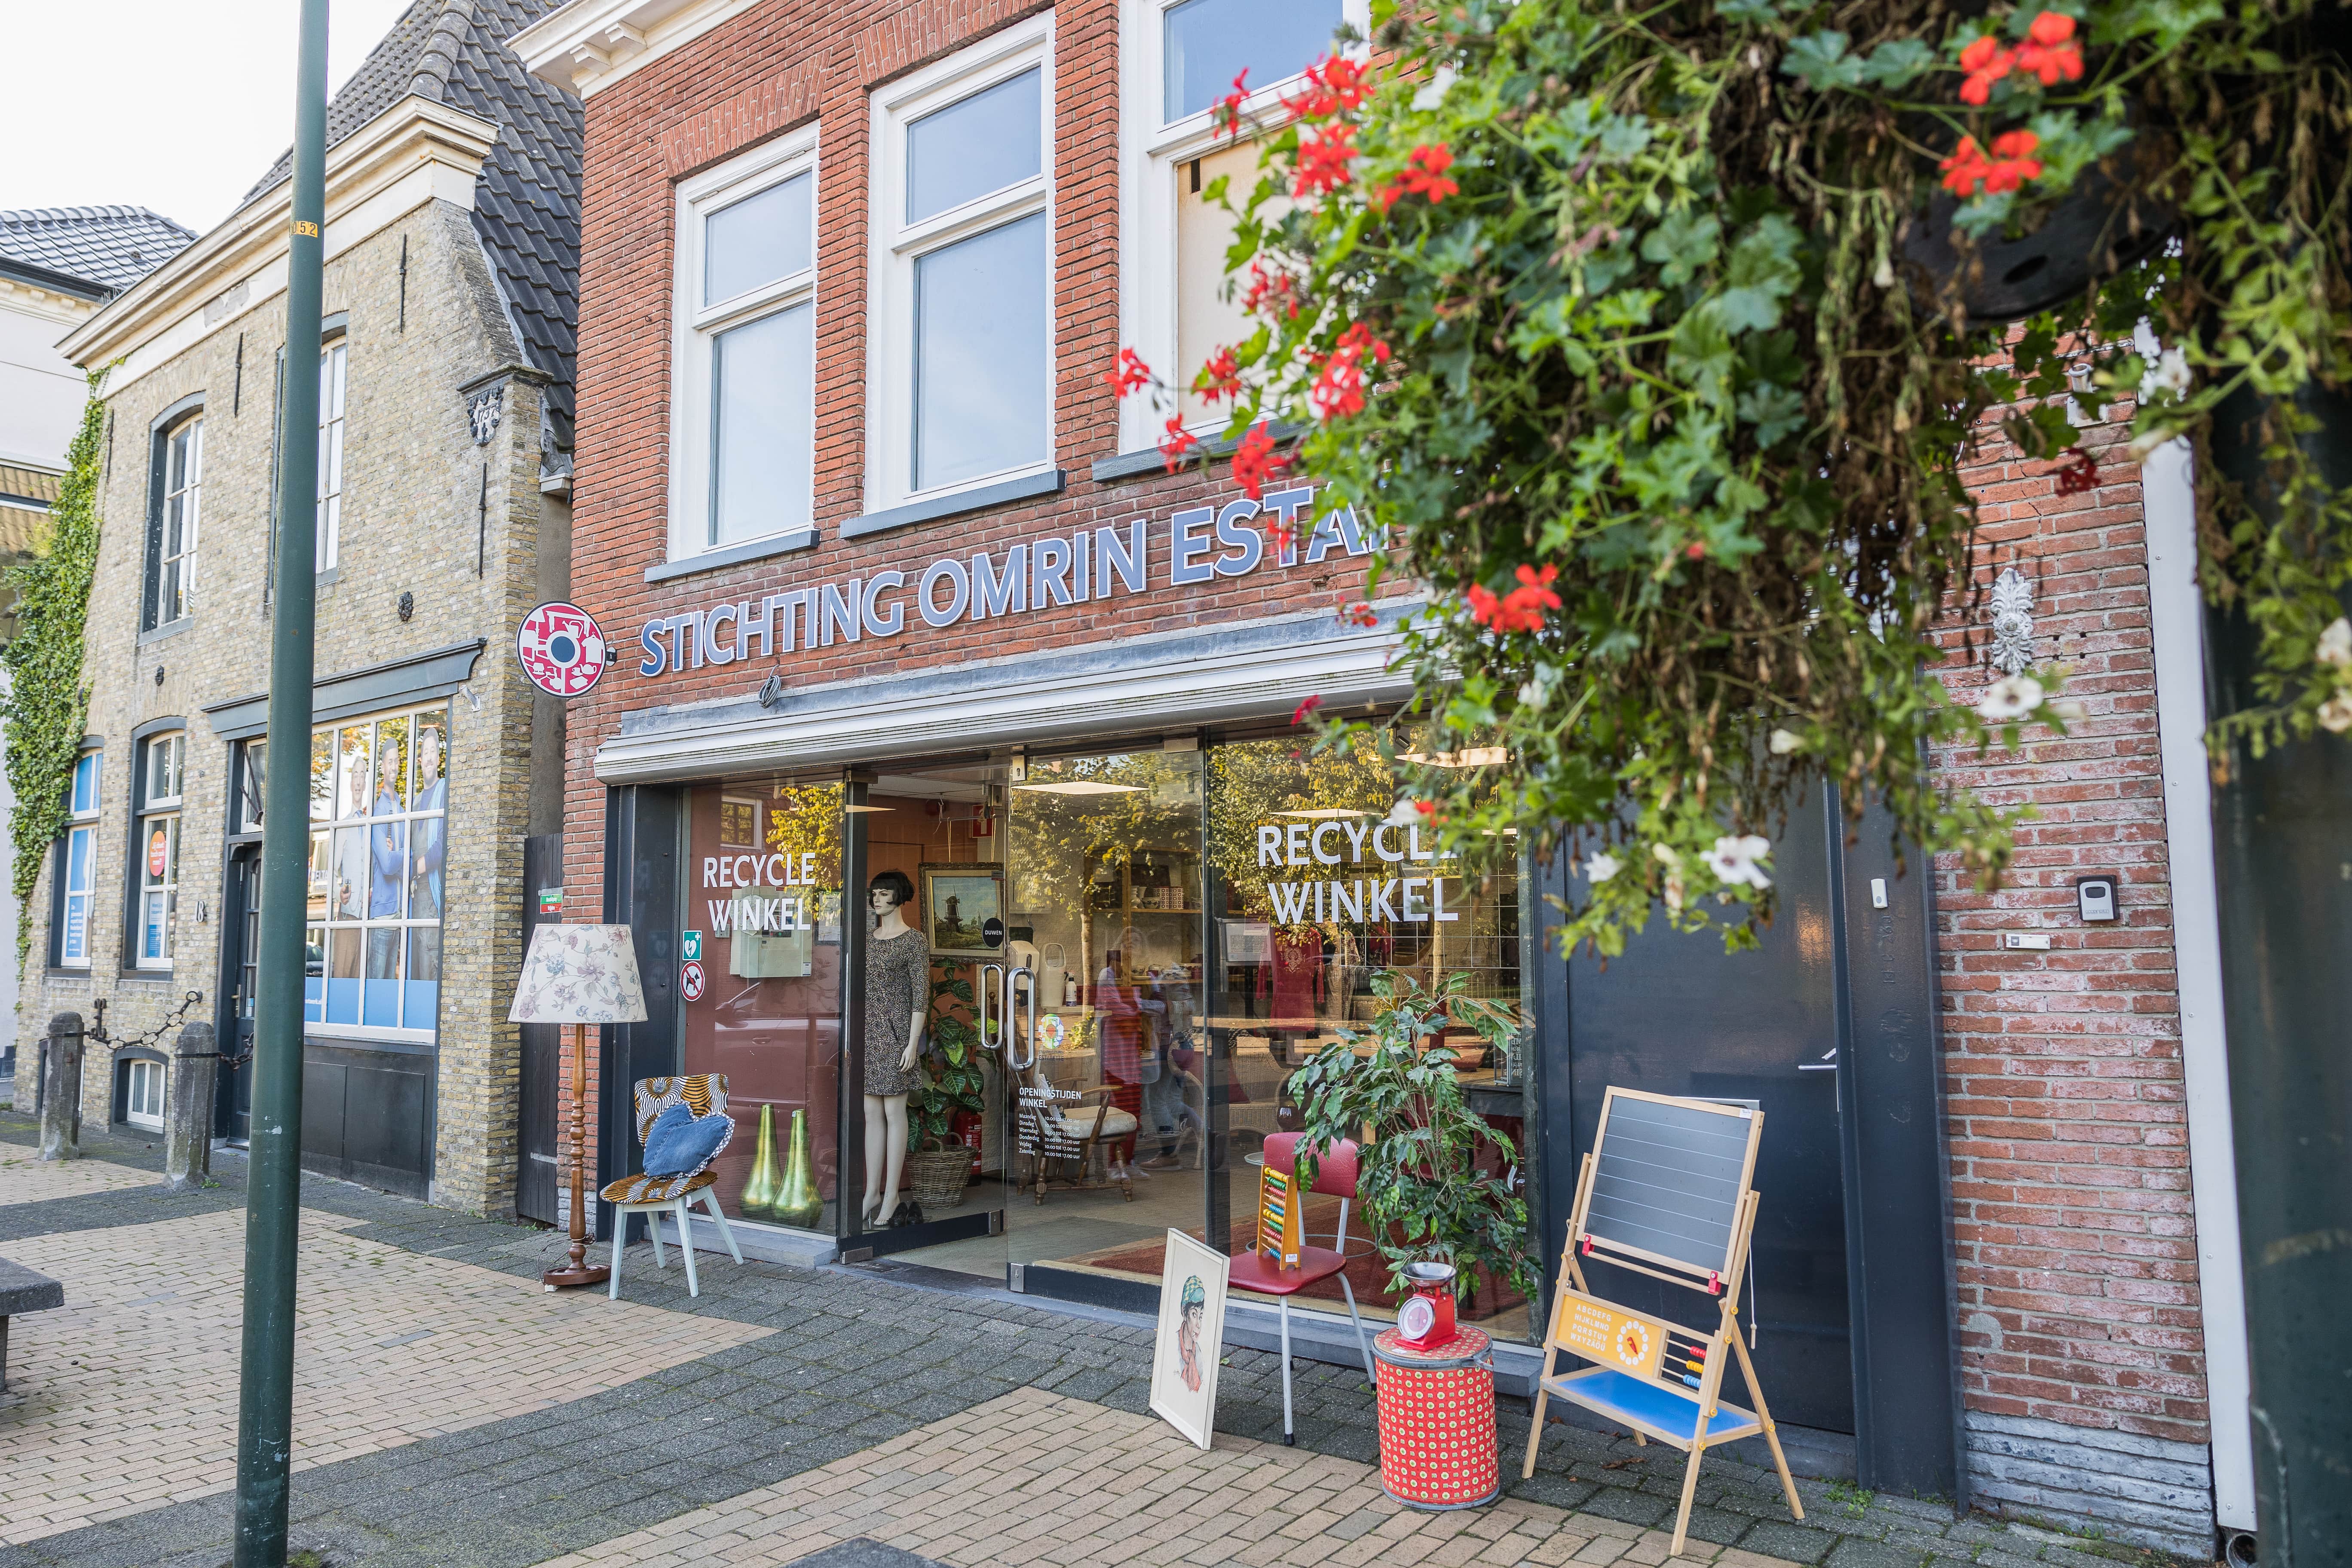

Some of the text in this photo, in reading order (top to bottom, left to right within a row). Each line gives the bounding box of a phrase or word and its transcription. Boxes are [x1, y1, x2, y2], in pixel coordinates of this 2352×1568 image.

[639, 469, 1392, 677] STICHTING OMRIN ESTA
[703, 852, 816, 888] RECYCLE
[195, 900, 205, 922] 18
[708, 898, 811, 932] WINKEL
[1267, 877, 1458, 925] WINKEL
[1019, 1087, 1081, 1099] OPENINGSTIJDEN
[1019, 1098, 1047, 1108] WINKEL
